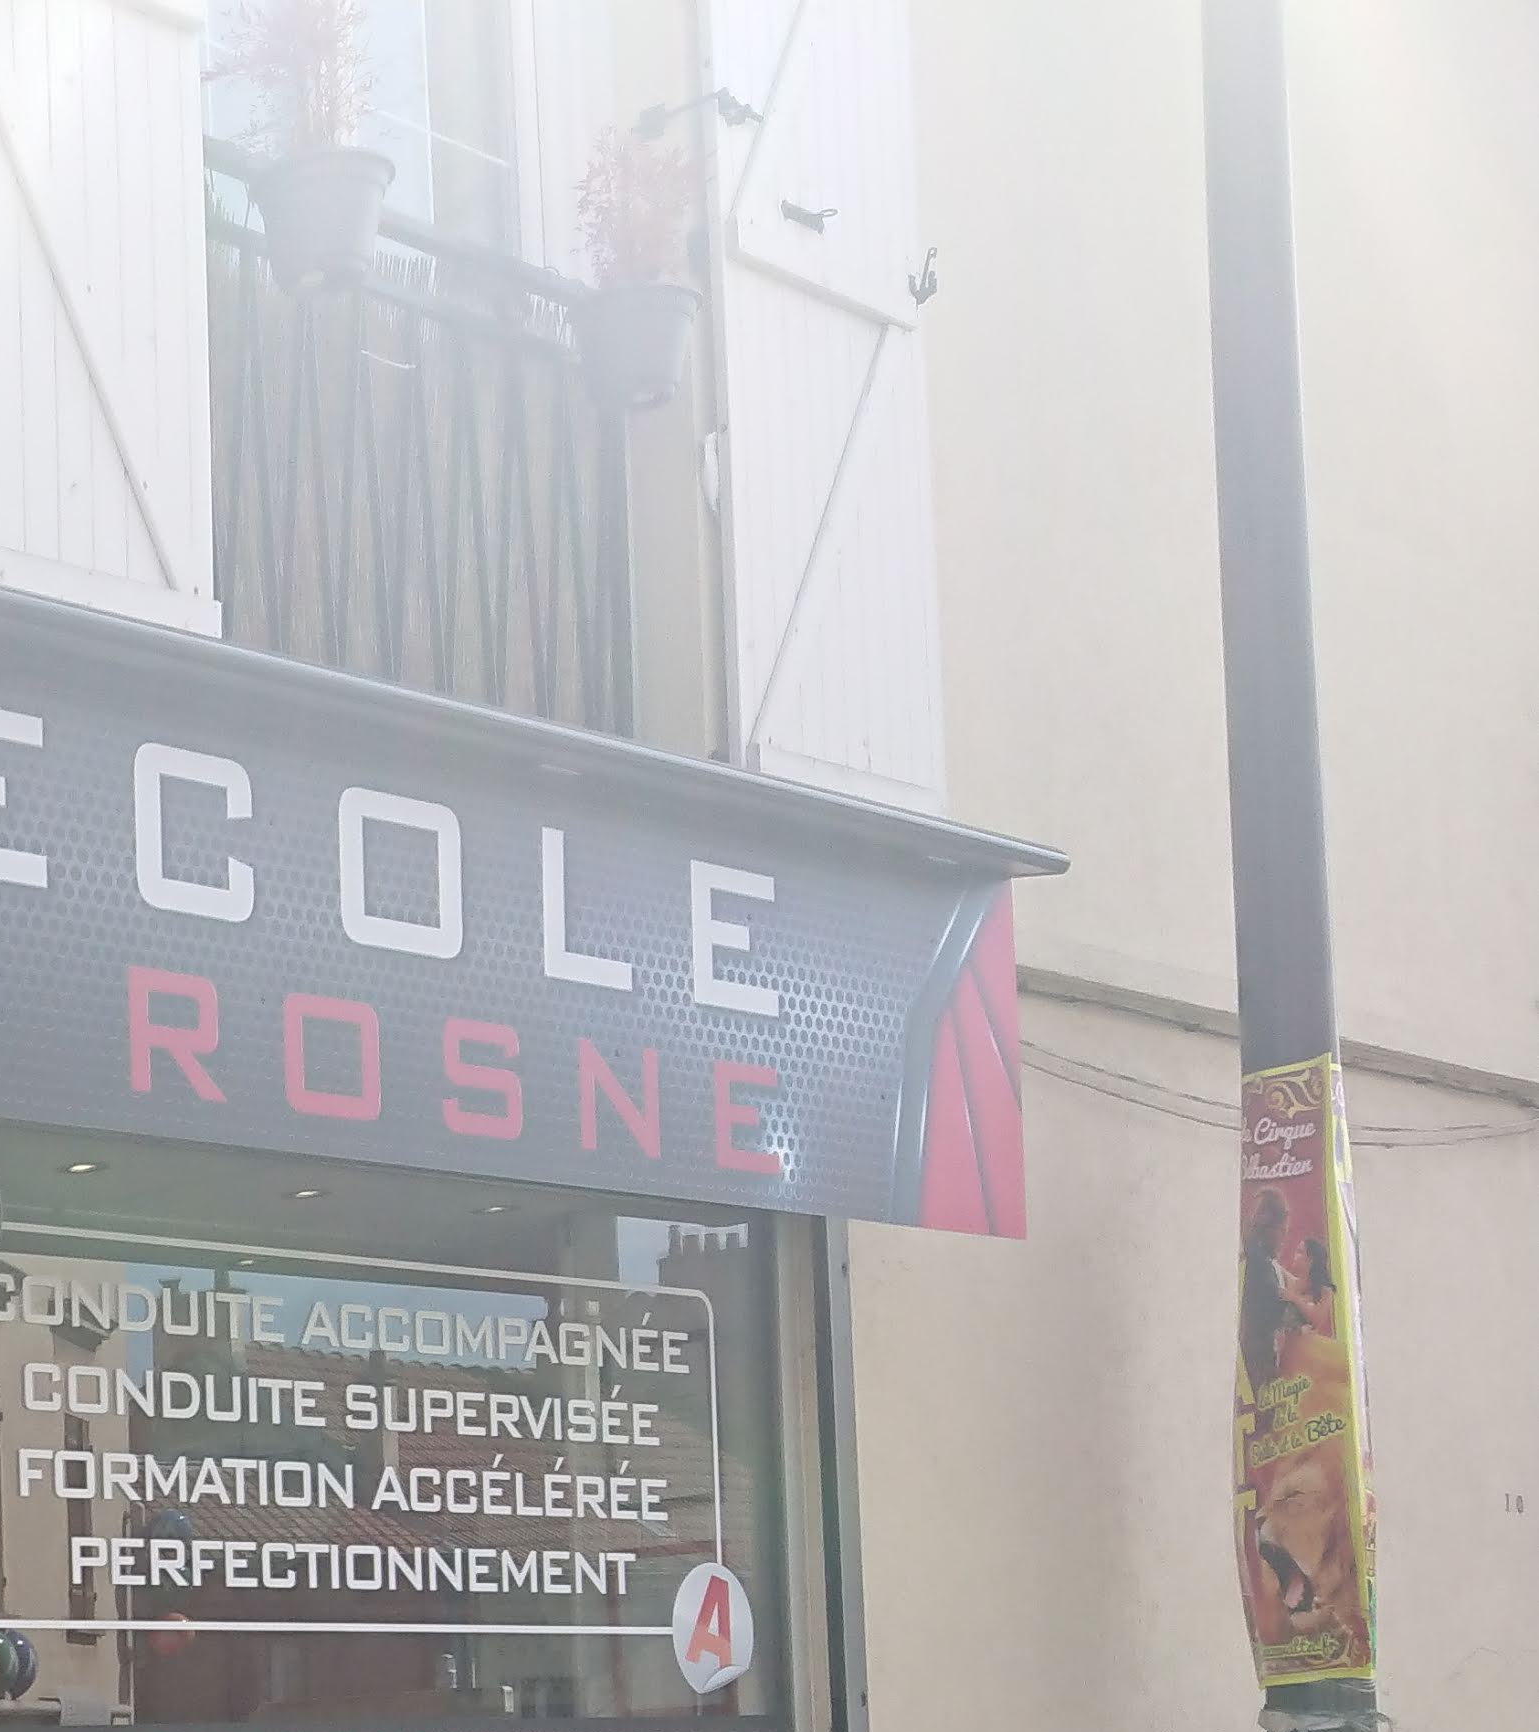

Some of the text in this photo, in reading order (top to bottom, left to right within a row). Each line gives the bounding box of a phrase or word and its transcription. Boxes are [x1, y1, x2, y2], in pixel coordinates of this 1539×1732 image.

[128, 964, 781, 1175] ROSNE
[1254, 1117, 1316, 1150] Cirque
[301, 1300, 690, 1375] ACCOMPAGNÉE
[20, 1362, 661, 1448] CONDUITE SUPERVISÉE
[18, 1448, 669, 1522] FORMATION ACCÉLÉRÉE
[70, 1536, 636, 1596] PERFECTIONNEMENT
[684, 1573, 733, 1670] A
